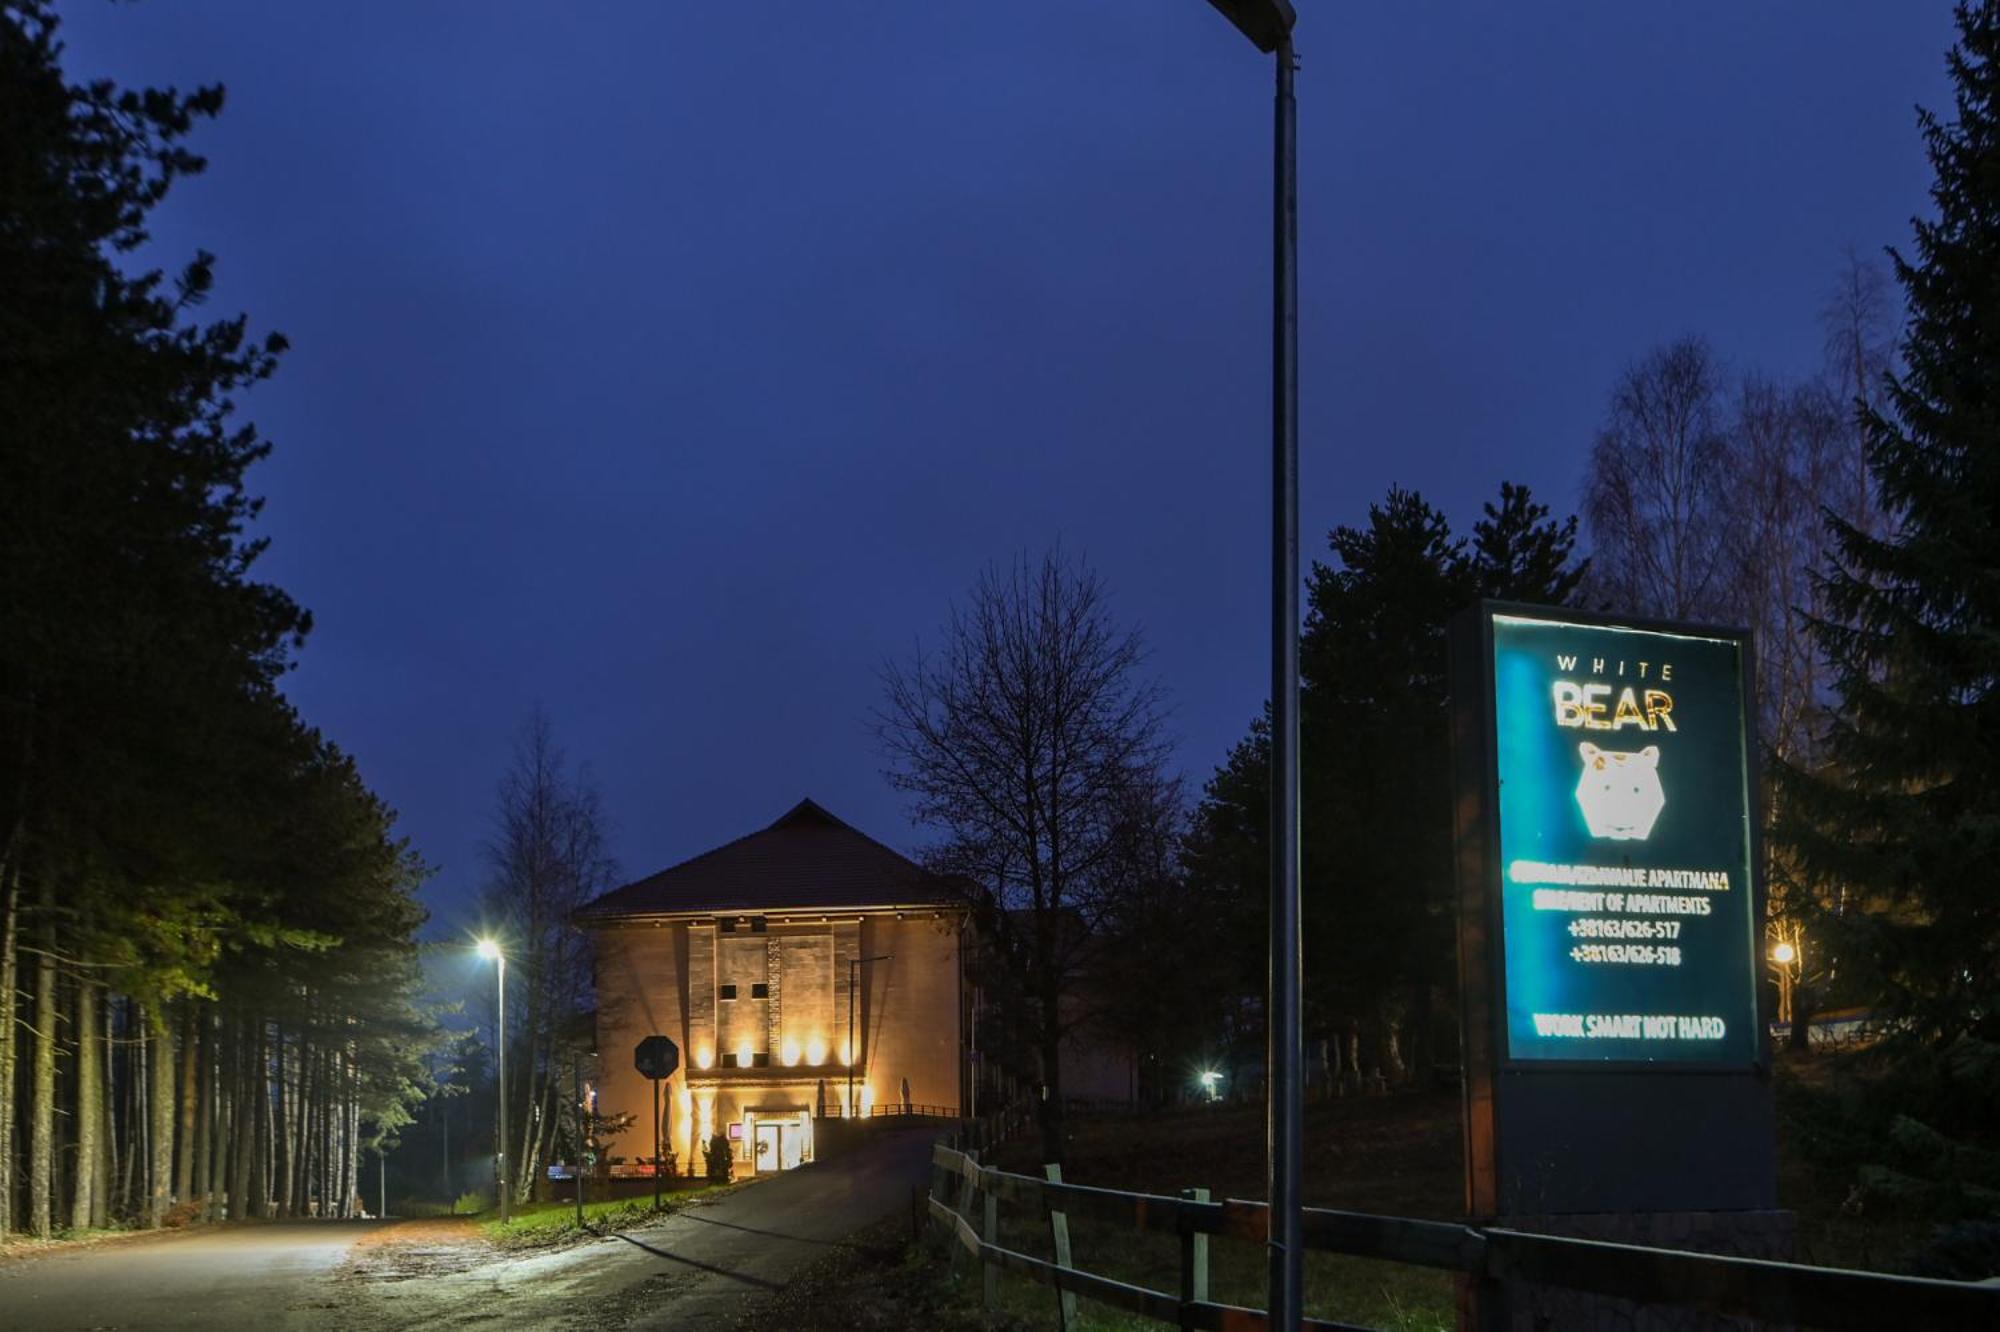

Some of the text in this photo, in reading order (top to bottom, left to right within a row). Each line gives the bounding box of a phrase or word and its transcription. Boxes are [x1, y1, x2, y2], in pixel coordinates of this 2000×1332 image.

[1557, 655, 1672, 681] WHITE
[1553, 681, 1677, 731] BEAR
[1649, 870, 1729, 890] APARTMANA
[1606, 893, 1624, 911] OF
[1626, 894, 1711, 915] APARTMENTS
[1586, 1015, 1642, 1038] SMART
[1642, 1016, 1677, 1039] NOT
[1679, 1017, 1725, 1038] HARD
